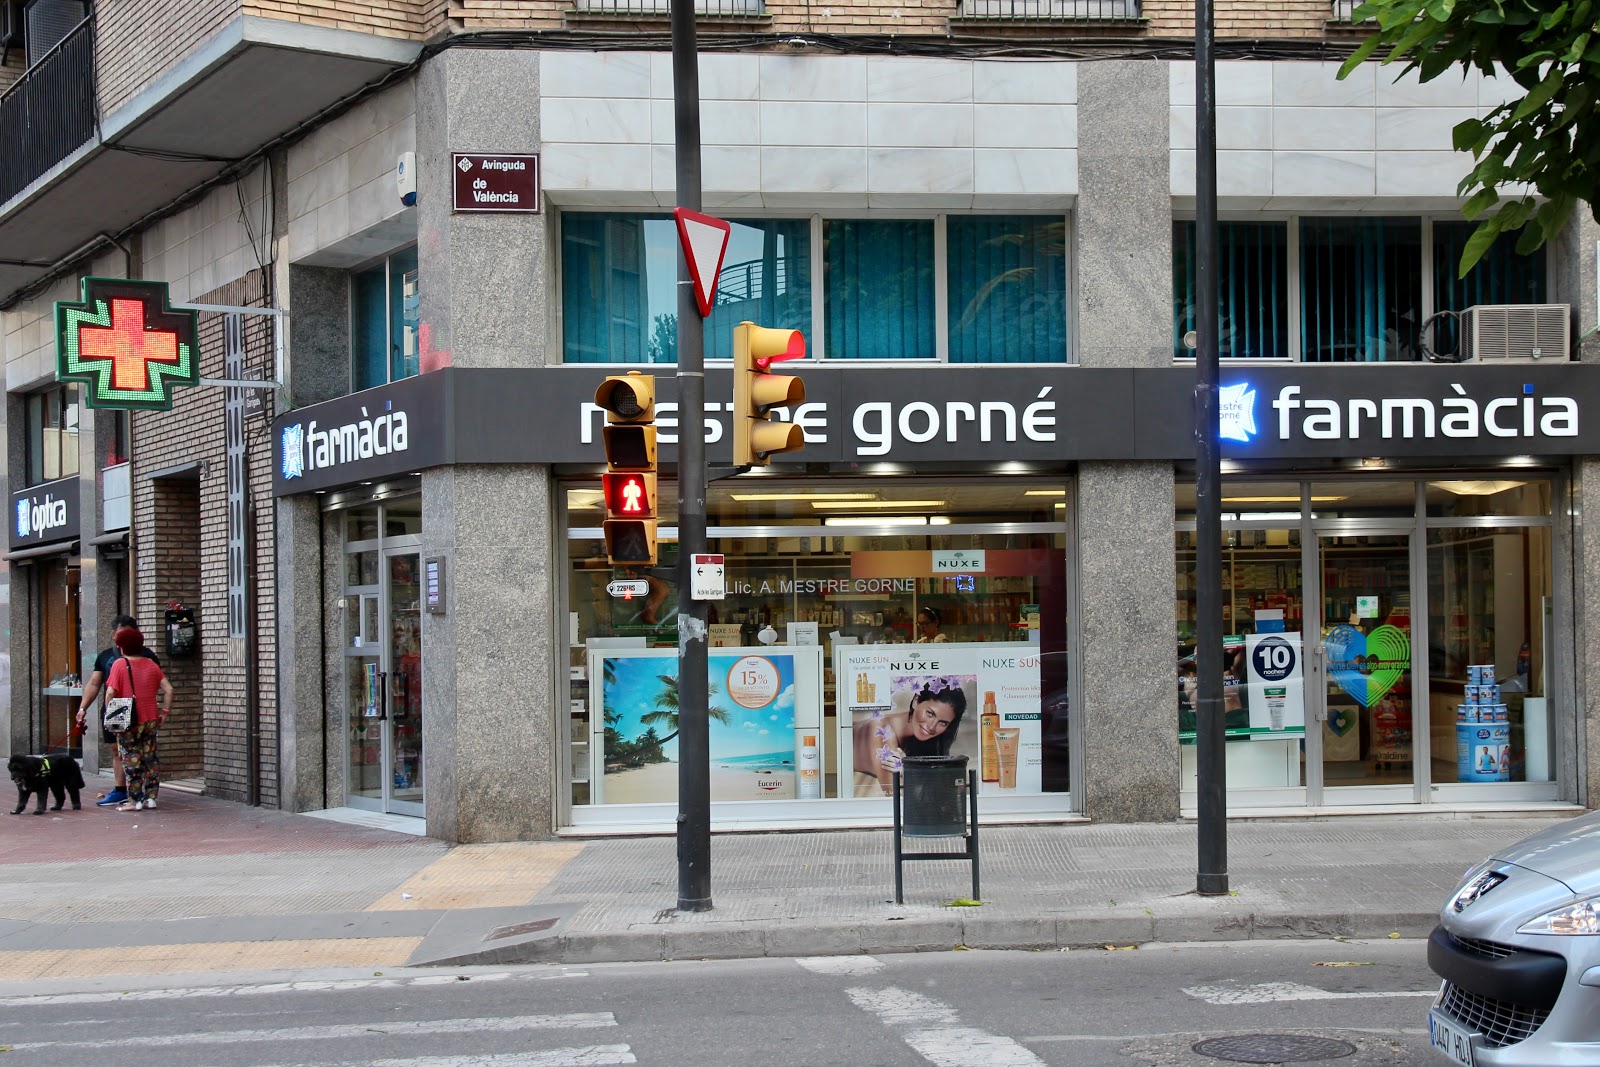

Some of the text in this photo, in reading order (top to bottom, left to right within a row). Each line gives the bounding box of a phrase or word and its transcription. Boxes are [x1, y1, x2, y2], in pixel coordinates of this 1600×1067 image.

[481, 160, 526, 172] Avinguda
[472, 178, 487, 189] de
[472, 191, 519, 203] València
[1219, 402, 1243, 411] estre
[1272, 383, 1579, 440] farmàcia
[580, 386, 1056, 456] ese gorné
[1219, 411, 1241, 420] orné
[306, 400, 408, 471] farmàcia
[32, 492, 67, 539] òptica
[938, 560, 980, 568] NUXE
[725, 576, 916, 594] Llic. A. MESTRE GORNÉ
[873, 656, 889, 664] SUN
[1259, 645, 1291, 669] 10
[890, 662, 940, 671] NUXE
[983, 658, 1041, 669] NUXE SUN
[1366, 660, 1378, 671] algo
[740, 670, 768, 686] 15%
[757, 779, 782, 787] Eucerin
[1433, 1019, 1450, 1053] 0447
